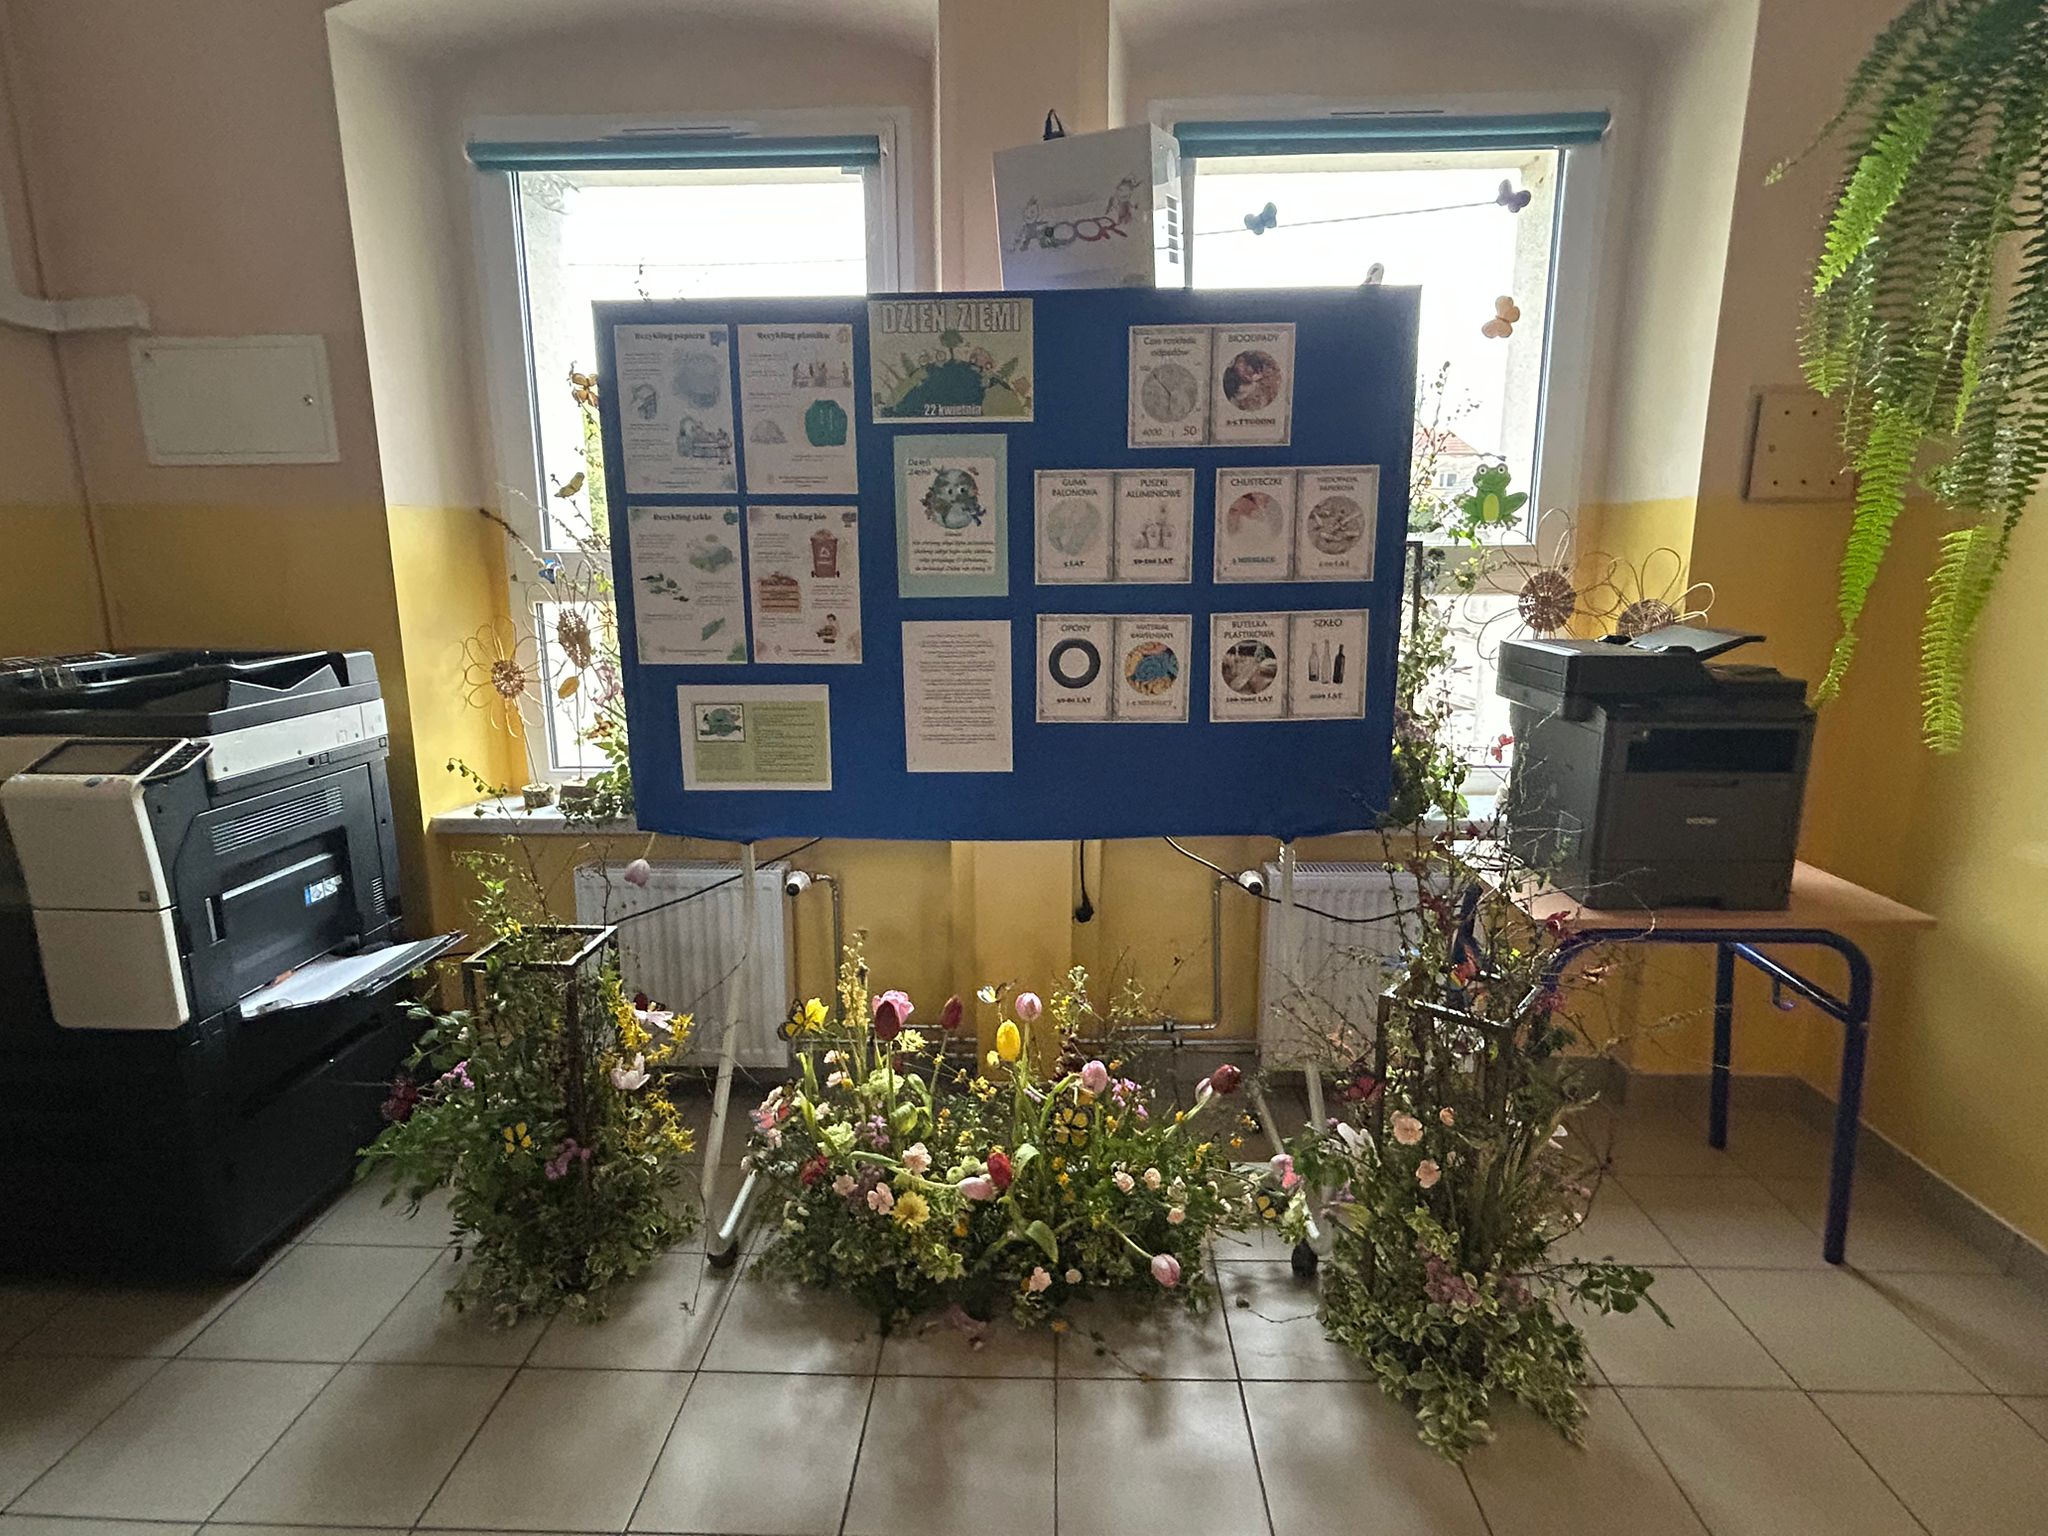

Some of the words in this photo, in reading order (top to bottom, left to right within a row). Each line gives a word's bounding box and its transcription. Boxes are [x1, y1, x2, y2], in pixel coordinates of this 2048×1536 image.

[881, 300, 946, 334] DZIEŃ
[958, 301, 1021, 333] ZIEMI
[634, 332, 673, 341] Recykling
[757, 332, 795, 341] Recykling
[924, 404, 936, 416] 22
[938, 404, 982, 416] kwietnia
[1140, 479, 1168, 487] PUSZKI
[1230, 478, 1282, 486] CHUSTECZKI
[1052, 488, 1098, 496] BALONOWA
[1126, 489, 1182, 498] ALUMINIOWE
[654, 513, 691, 522] Recykling
[776, 513, 813, 522] Recykling
[1232, 620, 1268, 628] BUTELKA
[1313, 618, 1342, 628] SZKŁO
[1061, 624, 1091, 632] OPONY
[1224, 631, 1274, 639] PLASTIKOWA
[1077, 696, 1091, 704] LAT
